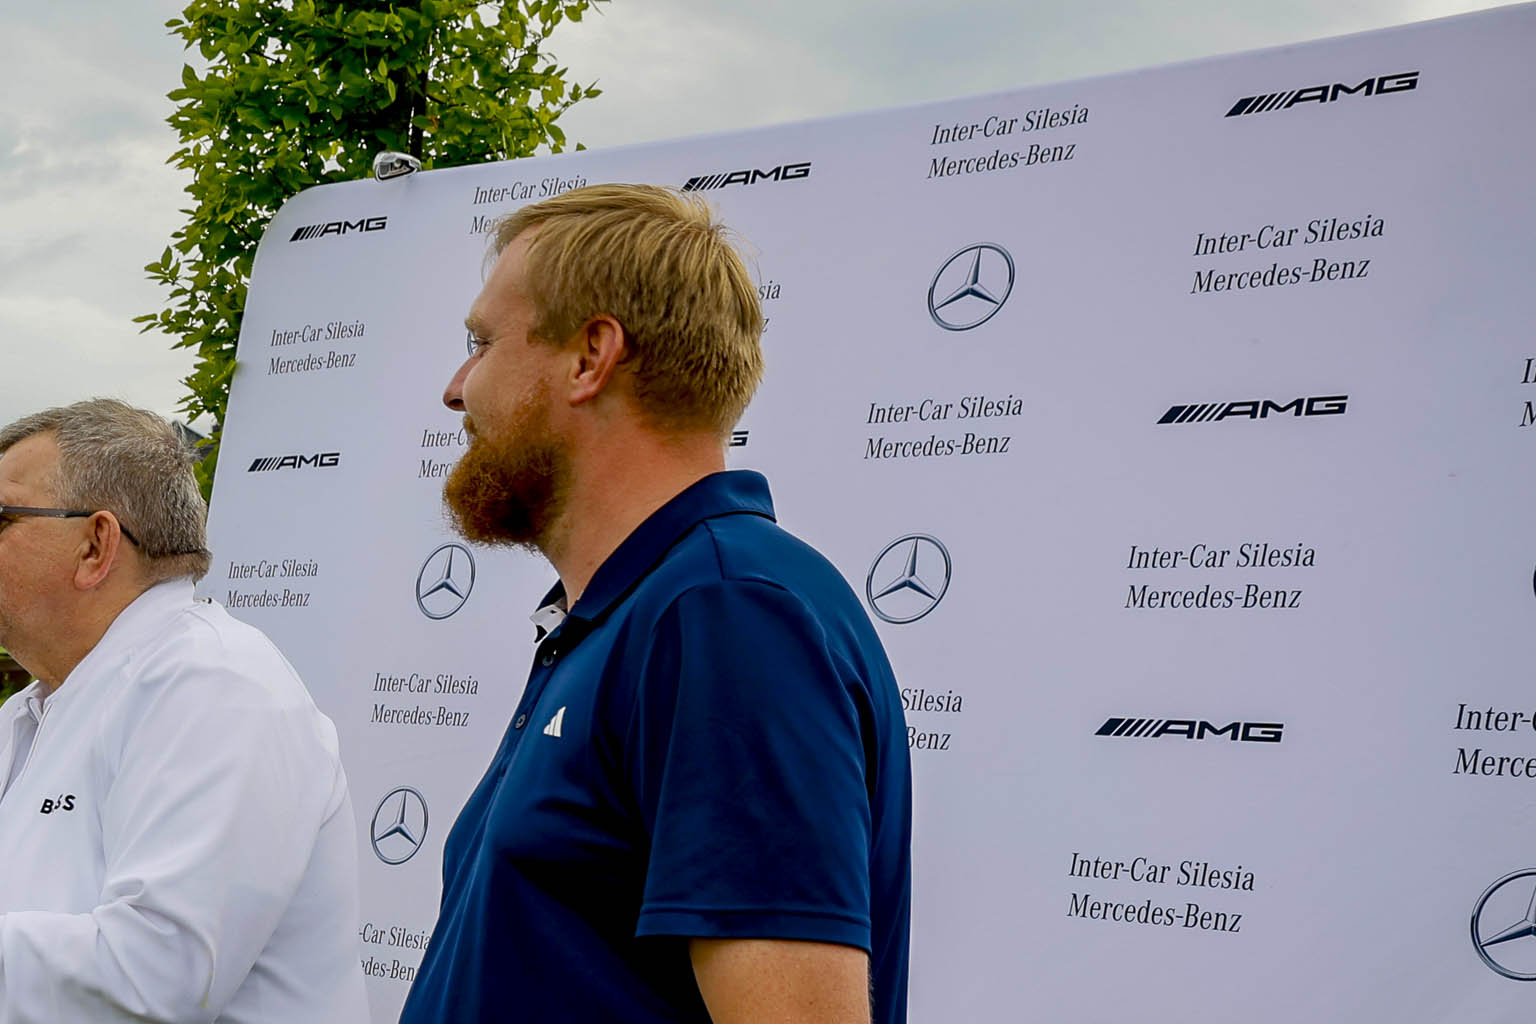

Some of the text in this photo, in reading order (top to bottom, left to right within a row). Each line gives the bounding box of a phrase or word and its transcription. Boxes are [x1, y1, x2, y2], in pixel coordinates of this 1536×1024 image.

[931, 104, 1089, 145] Inter-Car Silesia
[927, 143, 1076, 179] Mercedes-Benz
[473, 182, 536, 204] Inter-Car
[1193, 214, 1384, 256] Inter-Car Silesia
[1190, 258, 1371, 295] Mercedes-Benz
[271, 320, 364, 346] Inter-Car Silesia
[268, 351, 356, 375] Mercedes-Benz
[867, 394, 1023, 423] Inter-Car Silesia
[863, 431, 1010, 460] Mercedes-Benz
[228, 559, 318, 579] Inter-Car Silesia
[1127, 542, 1316, 570] Inter-Car Silesia
[226, 589, 310, 608] Mercedes-Benz
[1125, 583, 1302, 609] Mercedes-Benz
[373, 672, 478, 694] Inter-Car Silesia
[901, 688, 962, 712] Silesia
[371, 704, 469, 727] Mercedes-Benz
[1068, 852, 1256, 891] Inter-Car Silesia
[1067, 893, 1242, 933] Mercedes-Benz
